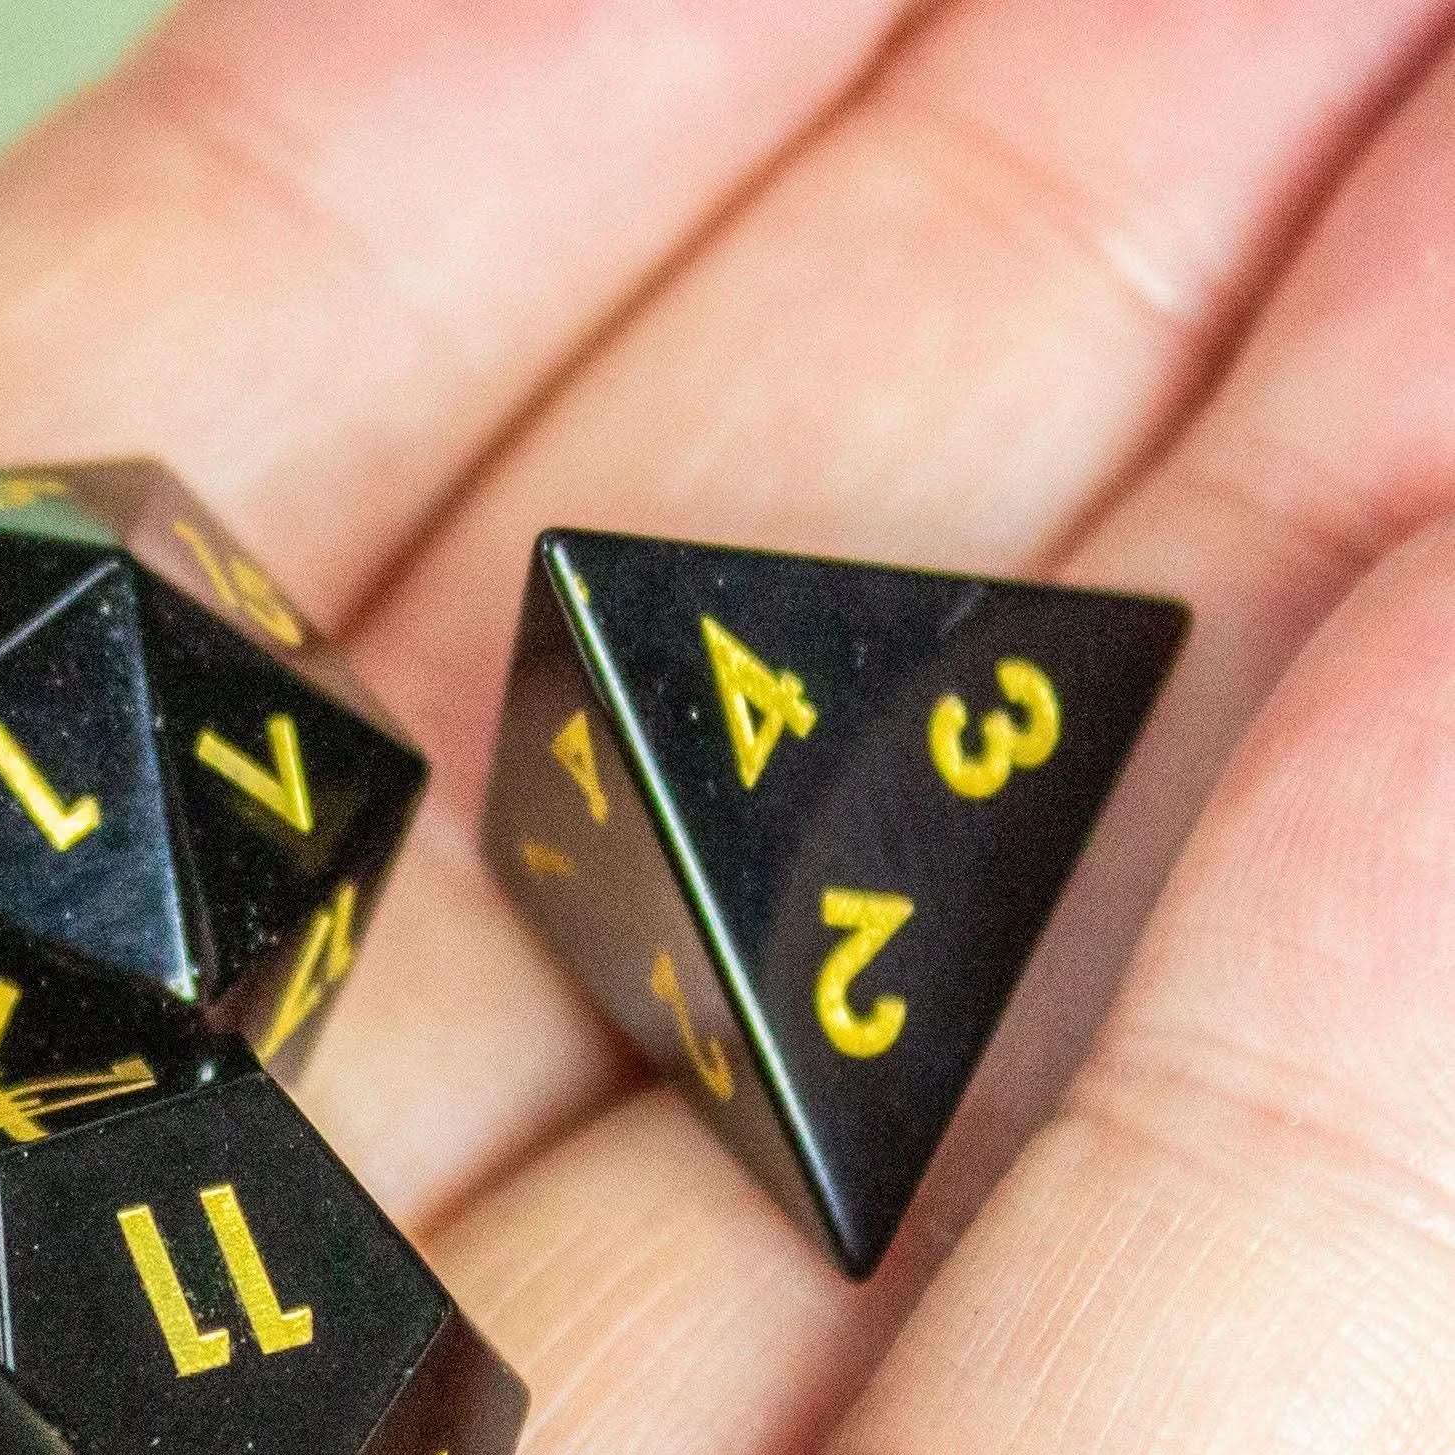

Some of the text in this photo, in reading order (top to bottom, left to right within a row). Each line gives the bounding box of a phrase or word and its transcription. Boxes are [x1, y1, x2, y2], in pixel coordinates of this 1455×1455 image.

[699, 614, 818, 792] 4
[926, 656, 1063, 801] 3
[812, 885, 915, 1061] 2
[117, 1188, 315, 1379] 11
